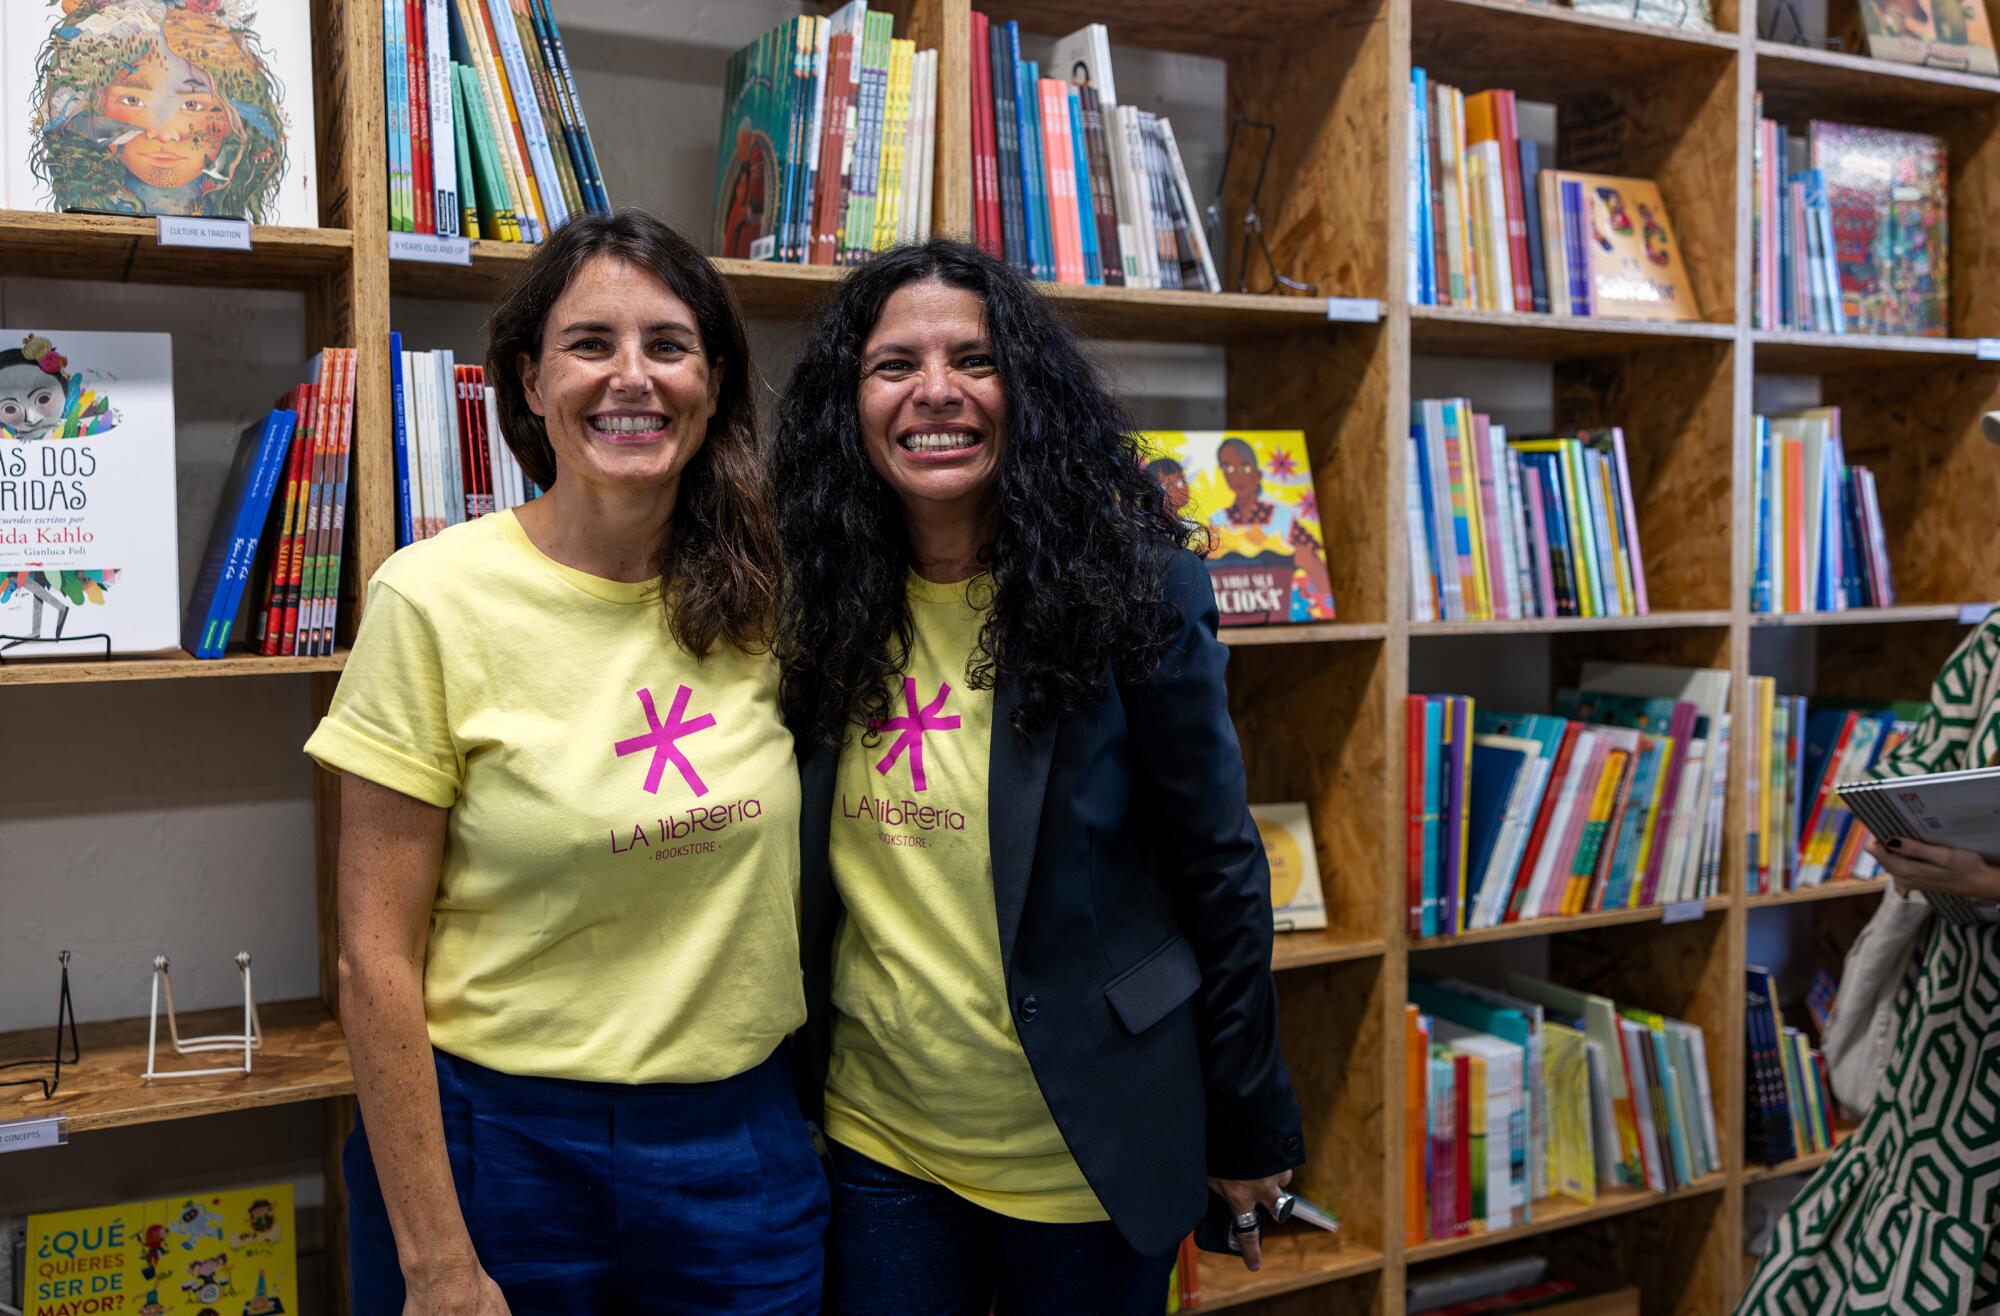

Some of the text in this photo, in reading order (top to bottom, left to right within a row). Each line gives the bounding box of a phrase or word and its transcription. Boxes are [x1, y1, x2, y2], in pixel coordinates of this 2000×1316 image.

[170, 226, 241, 239] CULTURE & TRADITION
[401, 242, 423, 252] YEARS
[424, 243, 438, 253] OLD
[440, 246, 454, 254] AND
[455, 247, 465, 255] UP
[42, 446, 96, 477] DOS
[0, 480, 87, 511] RIDAS
[34, 515, 66, 525] escritos
[68, 515, 85, 526] por
[0, 526, 94, 544] ida Kahlo
[24, 547, 66, 556] Gianluca
[843, 794, 874, 820] LA
[611, 824, 649, 854] LA
[655, 841, 716, 861] BOOKSTORE
[4, 1130, 41, 1142] CONCEPTS
[38, 1218, 125, 1259] ¿QUÉ
[39, 1253, 125, 1281] QUIERES
[38, 1273, 123, 1301] SER DE
[37, 1295, 125, 1316] MAYOR?
